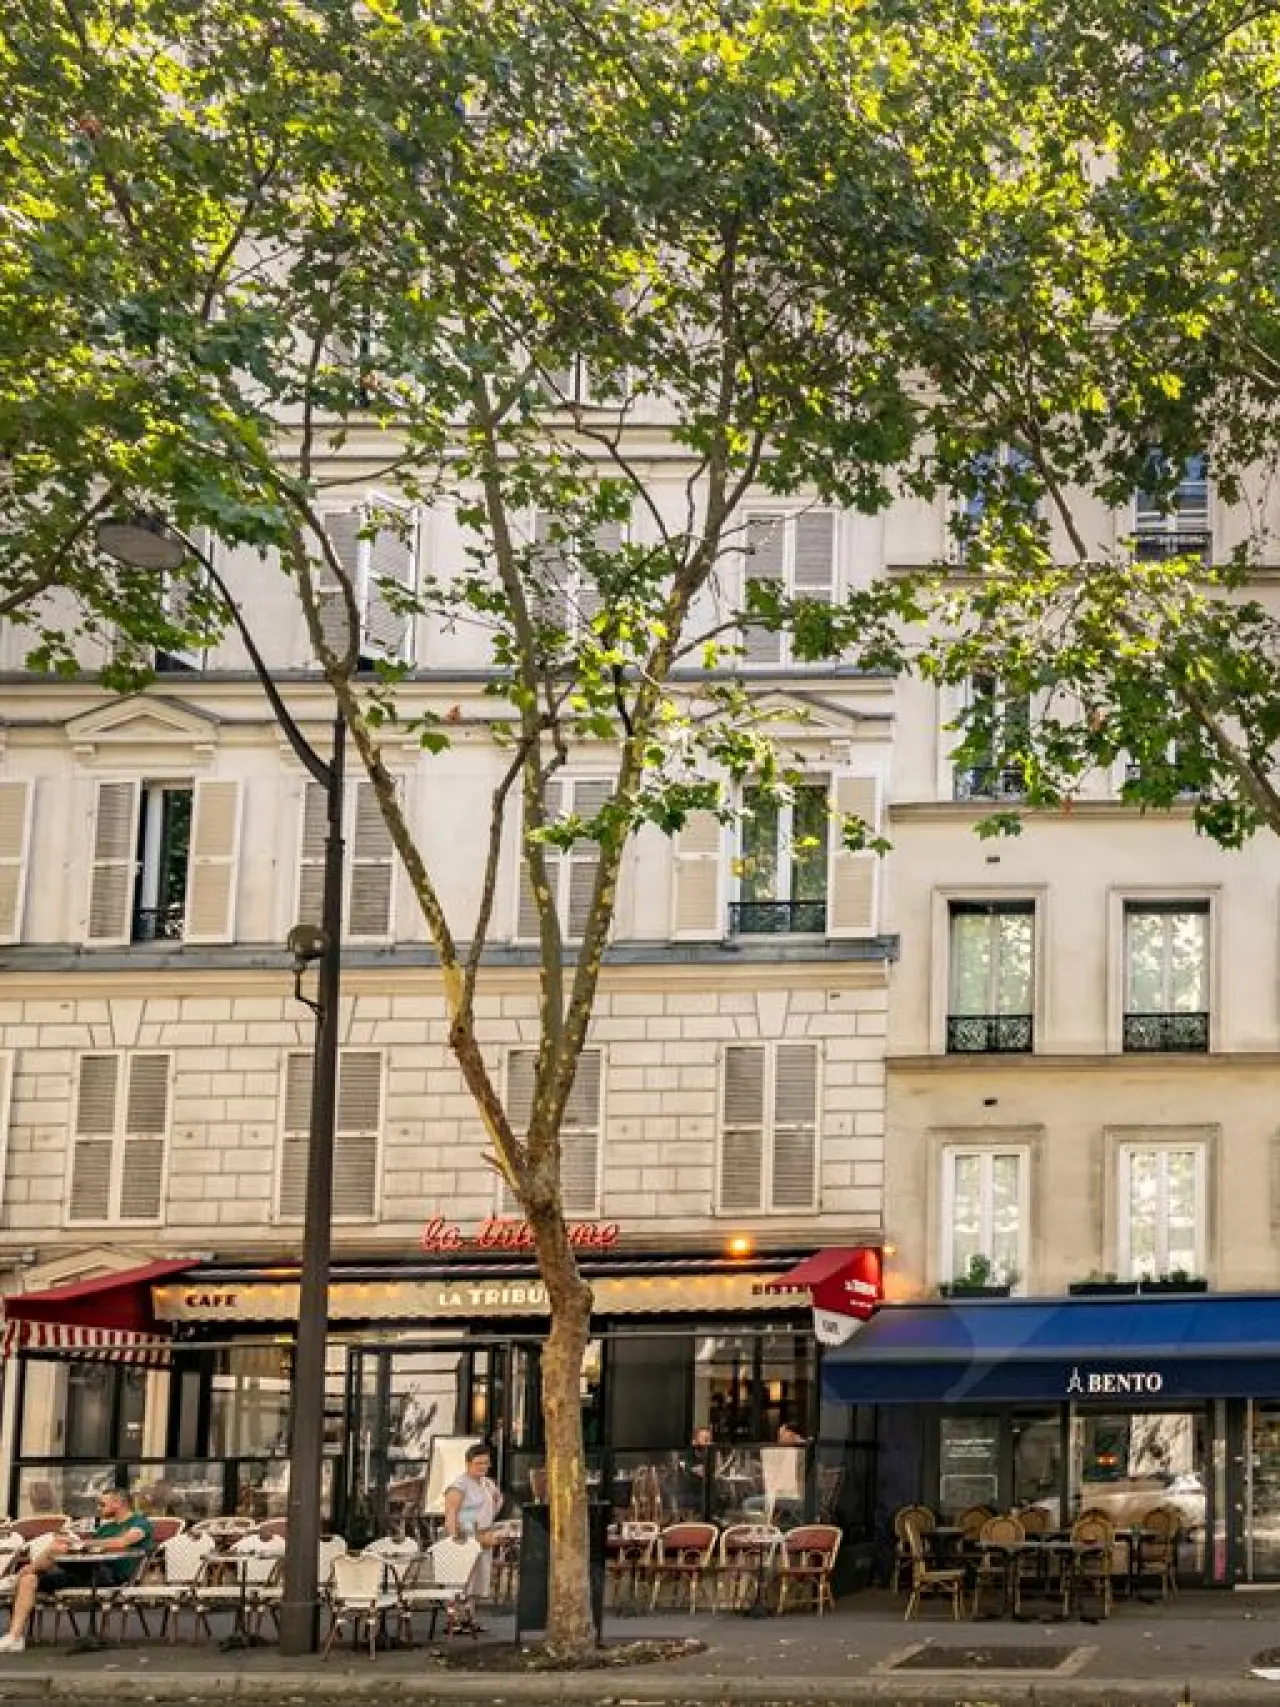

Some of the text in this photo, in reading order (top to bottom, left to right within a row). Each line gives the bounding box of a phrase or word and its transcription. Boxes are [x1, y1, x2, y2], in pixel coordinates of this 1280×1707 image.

[439, 1289, 549, 1306] LA TRIBU
[1087, 1372, 1163, 1393] BENTO
